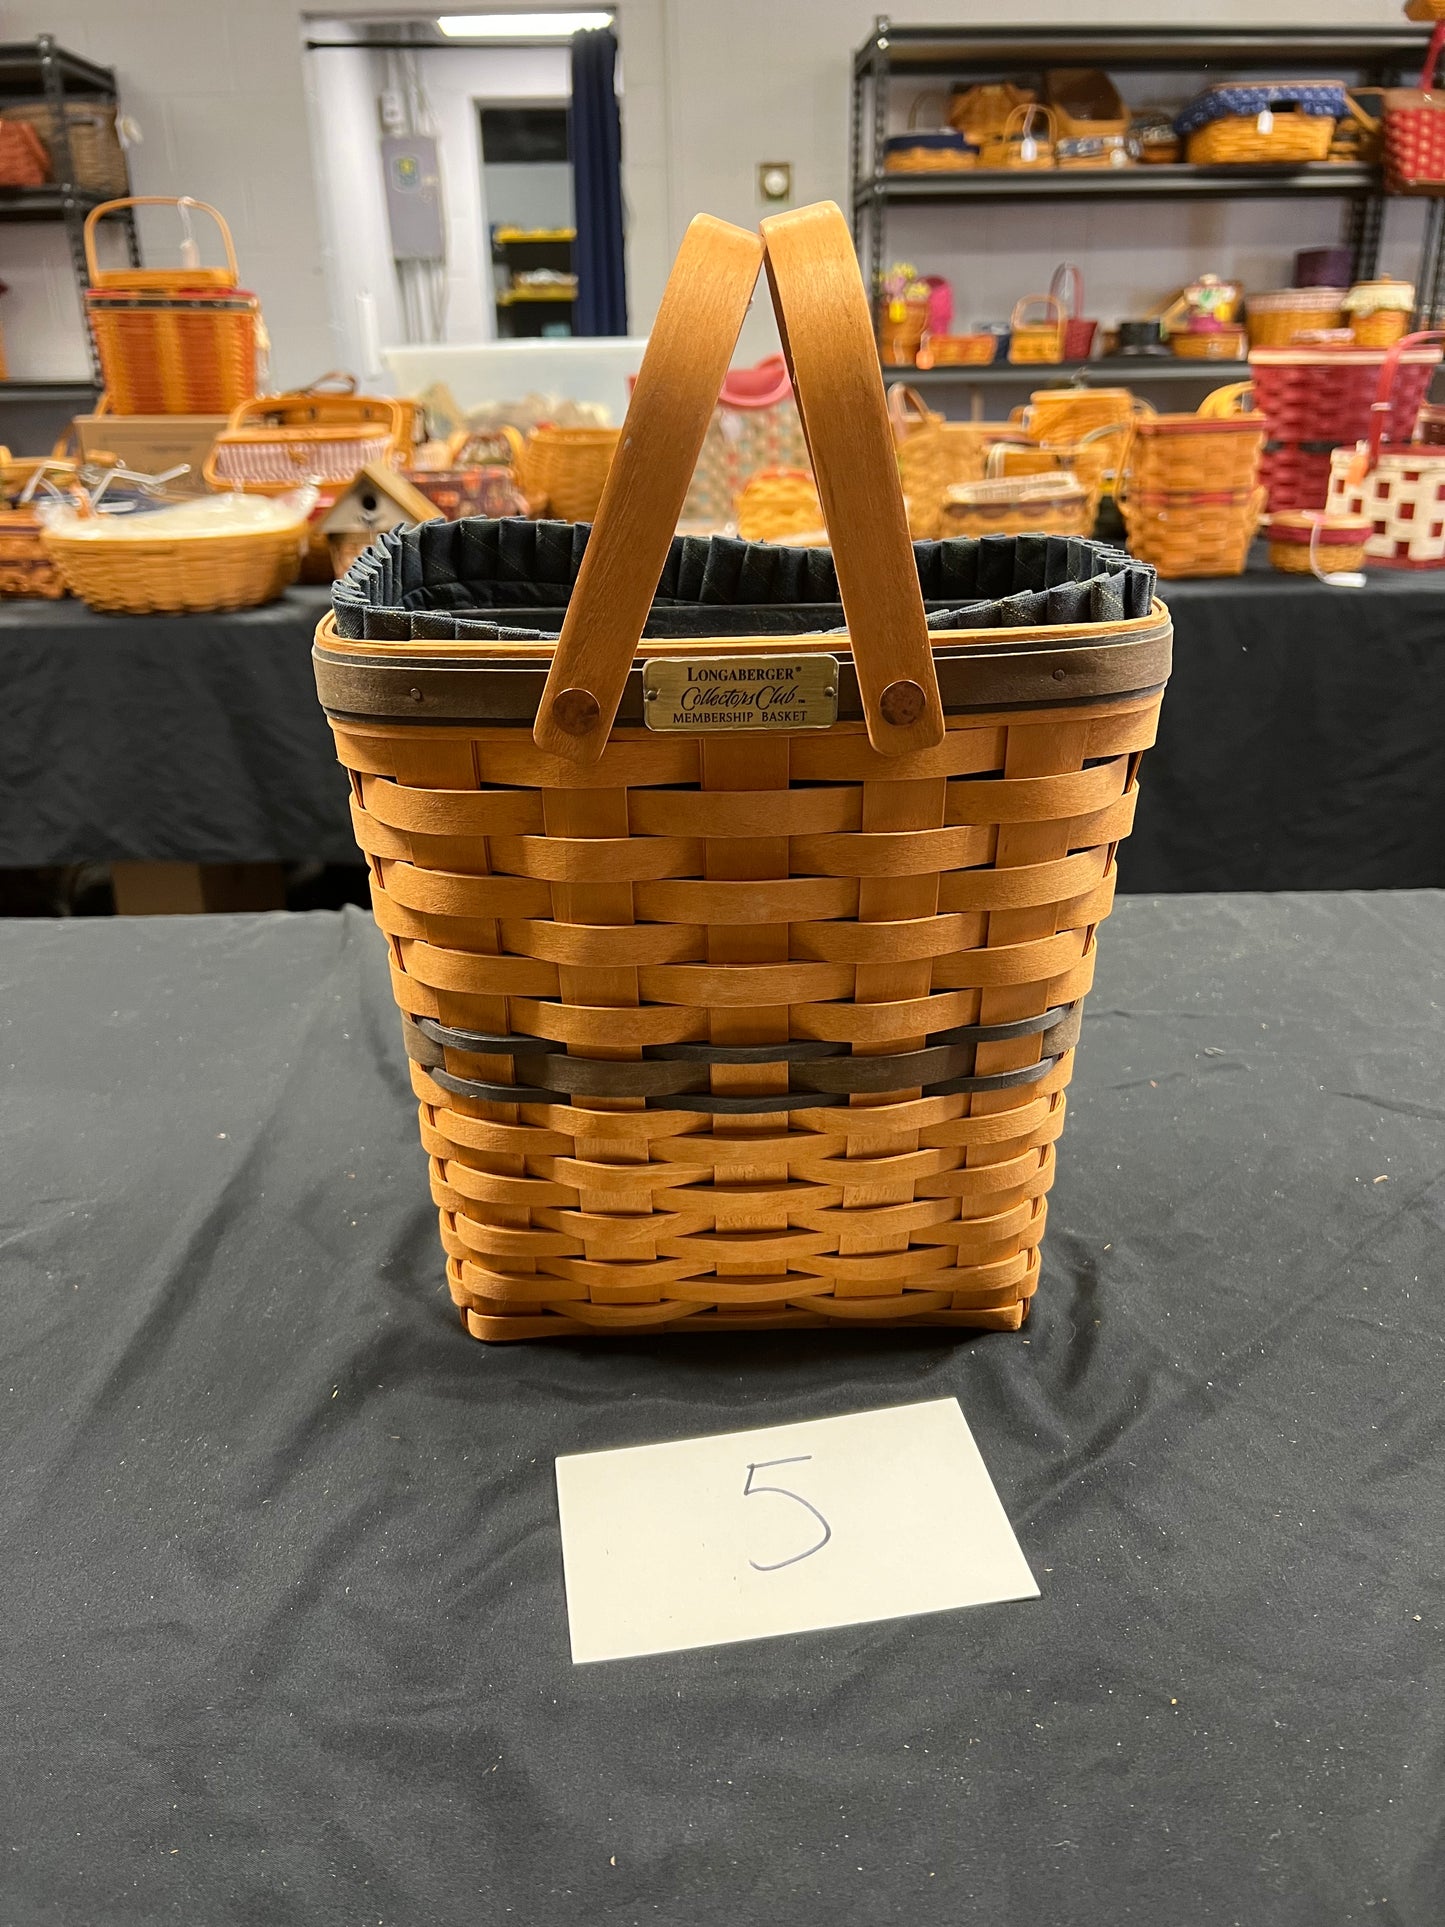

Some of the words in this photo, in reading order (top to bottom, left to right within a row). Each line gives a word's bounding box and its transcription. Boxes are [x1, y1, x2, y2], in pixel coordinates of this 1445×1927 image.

[681, 686, 755, 711] Collectors
[755, 685, 799, 710] Club
[672, 712, 754, 724] MEMBERSHIP
[761, 711, 808, 722] BASKET
[743, 1455, 831, 1571] 5
